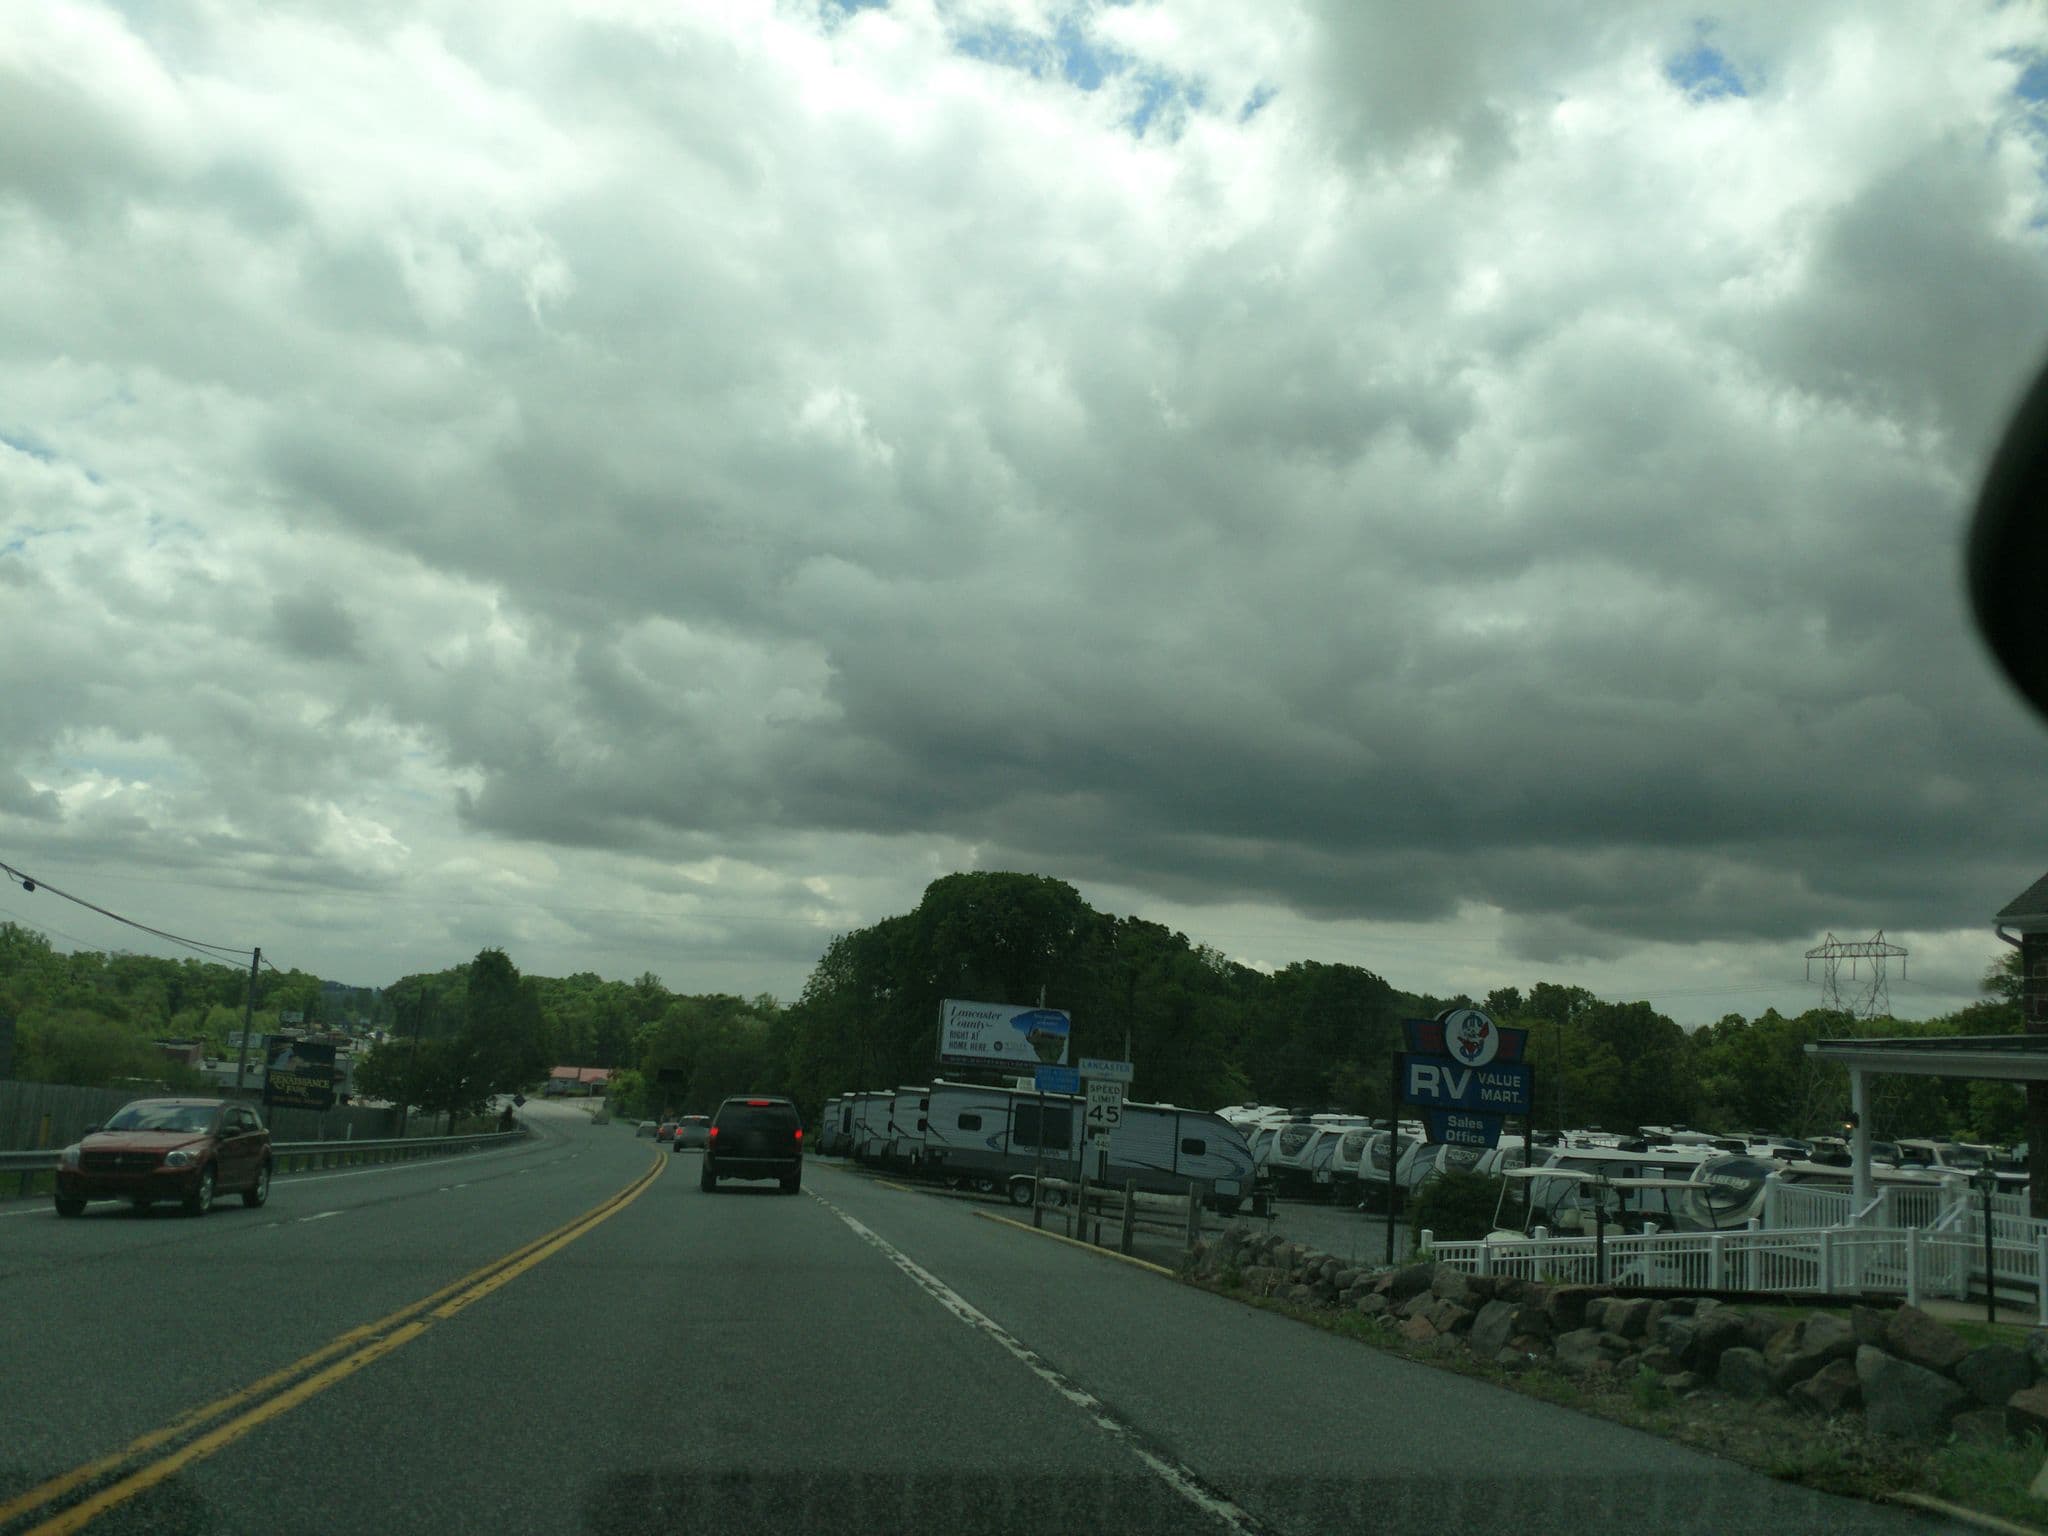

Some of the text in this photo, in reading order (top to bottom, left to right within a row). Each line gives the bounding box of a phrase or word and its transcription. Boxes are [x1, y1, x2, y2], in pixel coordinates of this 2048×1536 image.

[949, 1030, 981, 1040] RIGHT AT
[949, 1040, 968, 1050] HOME
[1082, 1061, 1130, 1073] LANCASTER
[1410, 1063, 1472, 1099] RV
[1477, 1072, 1521, 1088] VALUE
[1089, 1084, 1121, 1094] SPEED
[1481, 1088, 1520, 1104] MART
[1092, 1095, 1115, 1104] LIMIT
[1088, 1105, 1119, 1123] 45
[1447, 1115, 1483, 1130] Sales
[1445, 1129, 1485, 1144] Office
